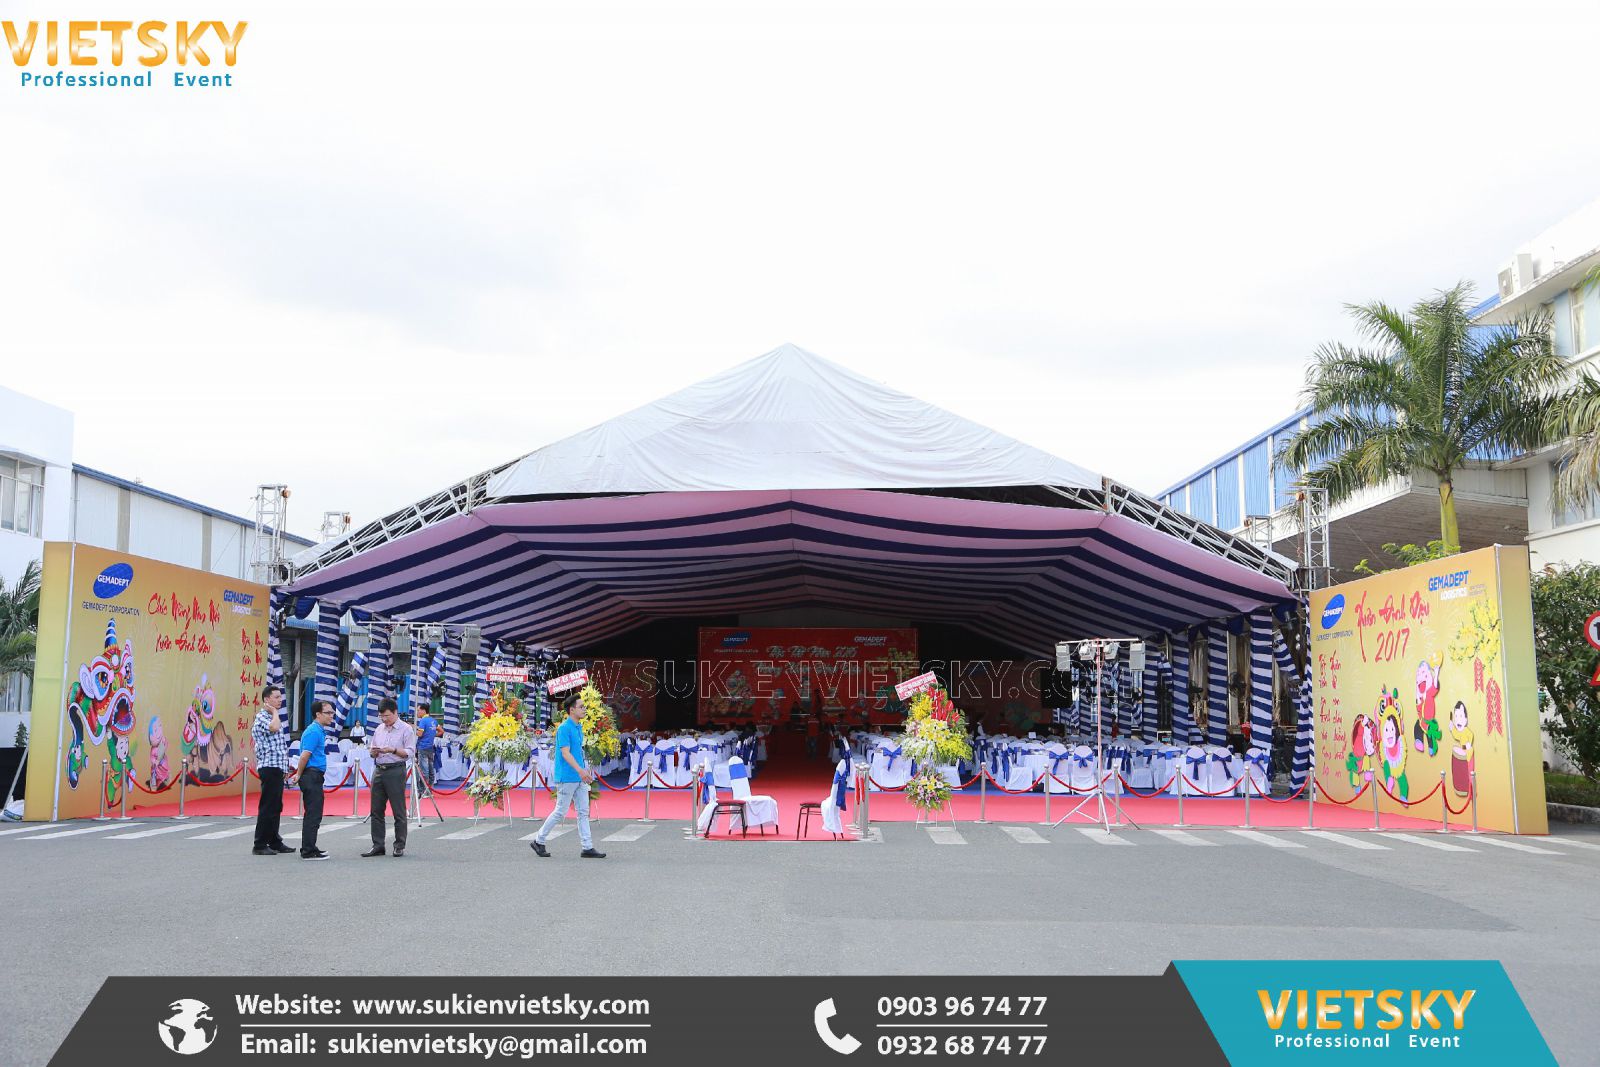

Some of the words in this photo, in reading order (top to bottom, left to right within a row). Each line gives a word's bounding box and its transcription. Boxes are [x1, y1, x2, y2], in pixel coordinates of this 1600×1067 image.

[97, 574, 130, 587] GEMADEPT
[1428, 570, 1469, 592] GEMADEPT
[223, 589, 254, 607] GEMADEPT
[82, 600, 108, 613] GEMADEPT
[108, 603, 140, 617] CORPORATION
[1323, 606, 1344, 617] GEMADEPT
[1375, 628, 1411, 664] 2017
